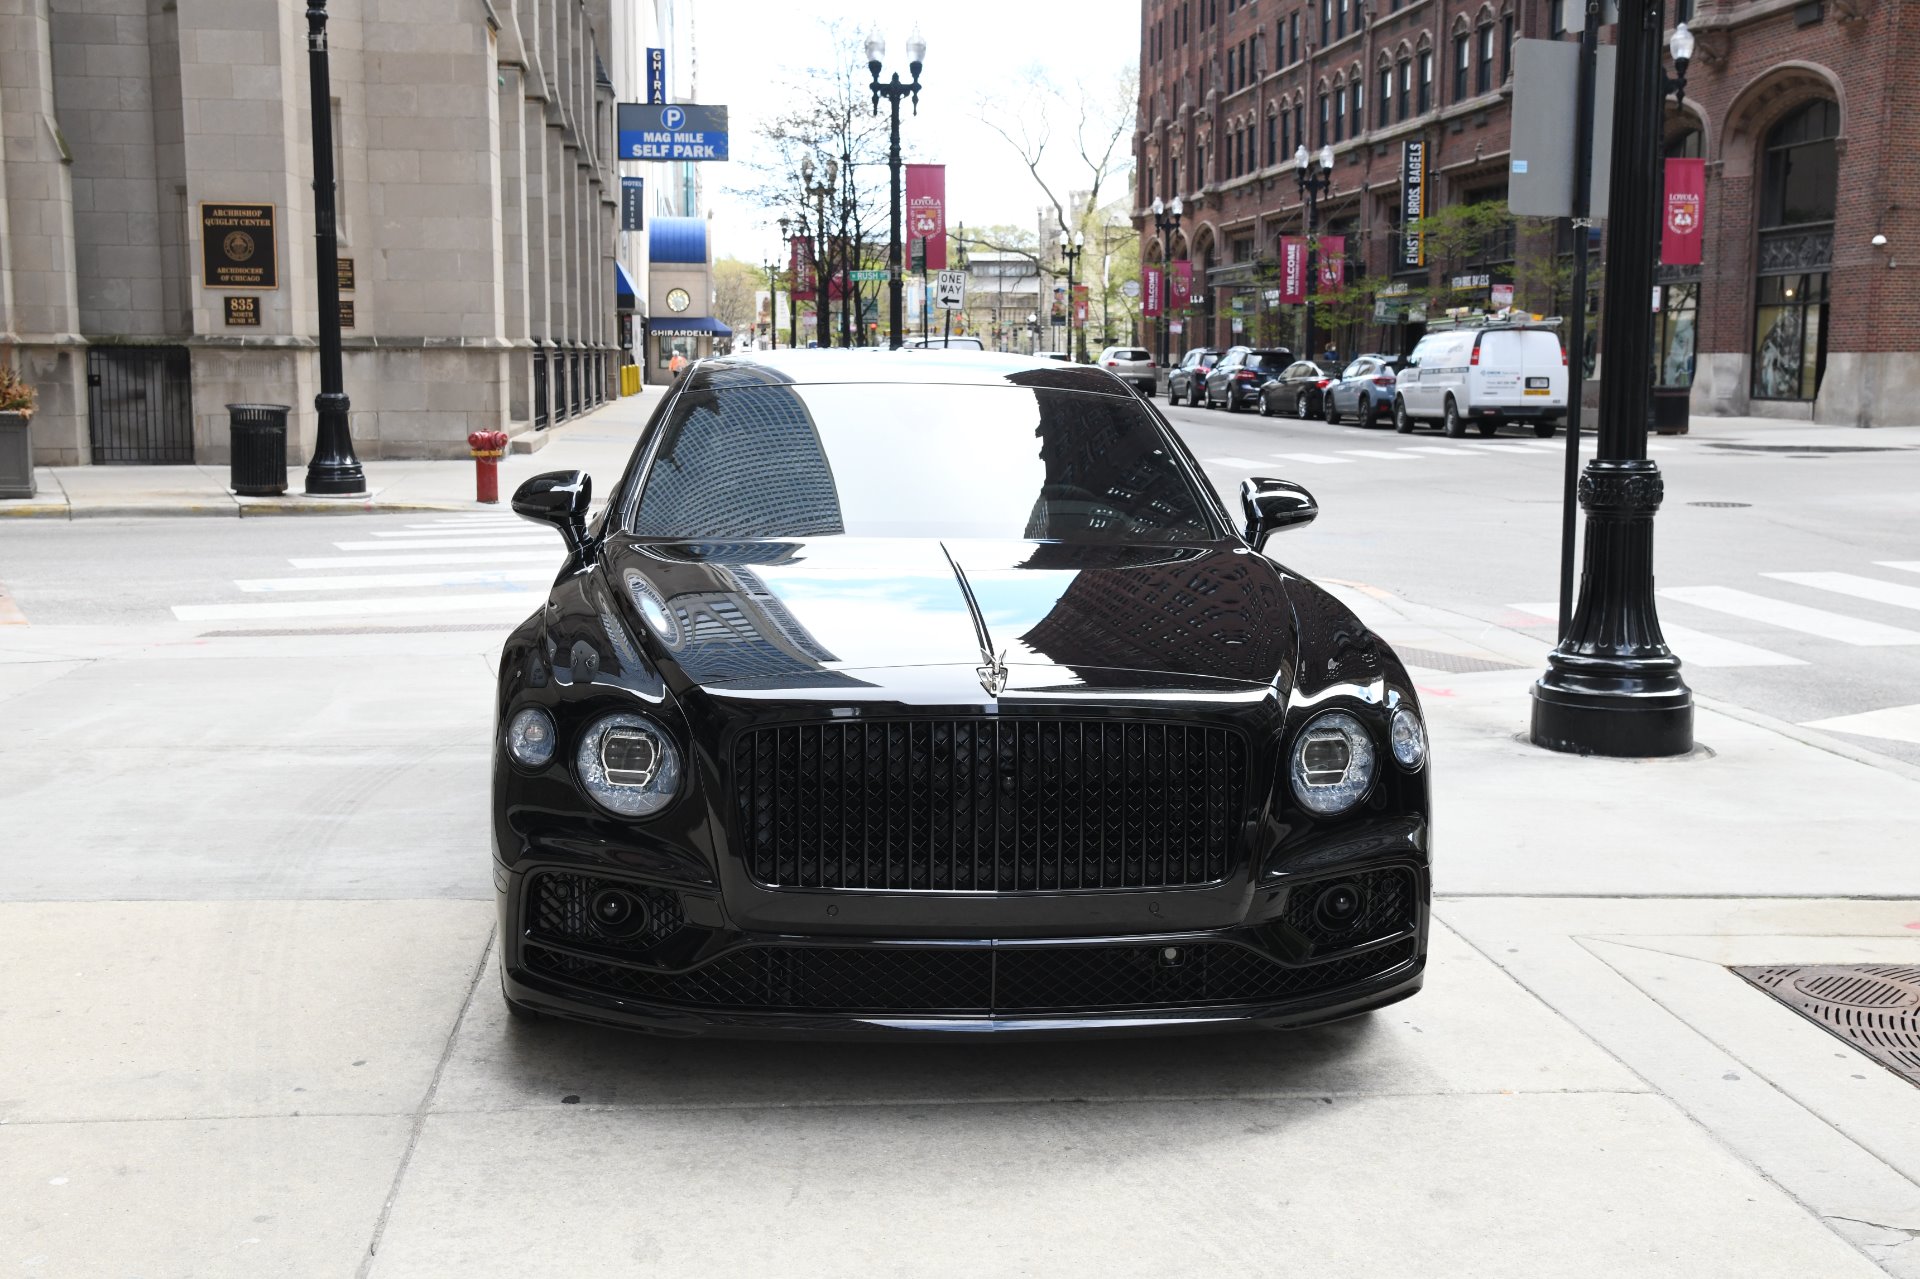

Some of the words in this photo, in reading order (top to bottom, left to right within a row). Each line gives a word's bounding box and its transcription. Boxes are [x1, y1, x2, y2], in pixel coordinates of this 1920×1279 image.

[667, 109, 681, 127] P
[643, 132, 671, 143] MAG
[674, 133, 704, 143] MILE
[632, 144, 669, 157] SELF
[673, 145, 715, 158] PARK
[1409, 143, 1422, 184] BAGELS
[910, 198, 941, 206] LOYOLA
[1669, 193, 1699, 201] LOYOLA
[212, 209, 263, 217] ARCHBISHOP
[204, 218, 239, 227] QUIGLEY
[240, 218, 271, 227] CENTER
[217, 267, 264, 275] ARCHDIOCESE
[1286, 244, 1296, 295] WELCOME
[857, 272, 879, 280] RUSH
[941, 273, 962, 284] ONE
[940, 284, 962, 295] WAY
[230, 298, 254, 311] 835
[650, 329, 713, 337] GHIRARDELLI
